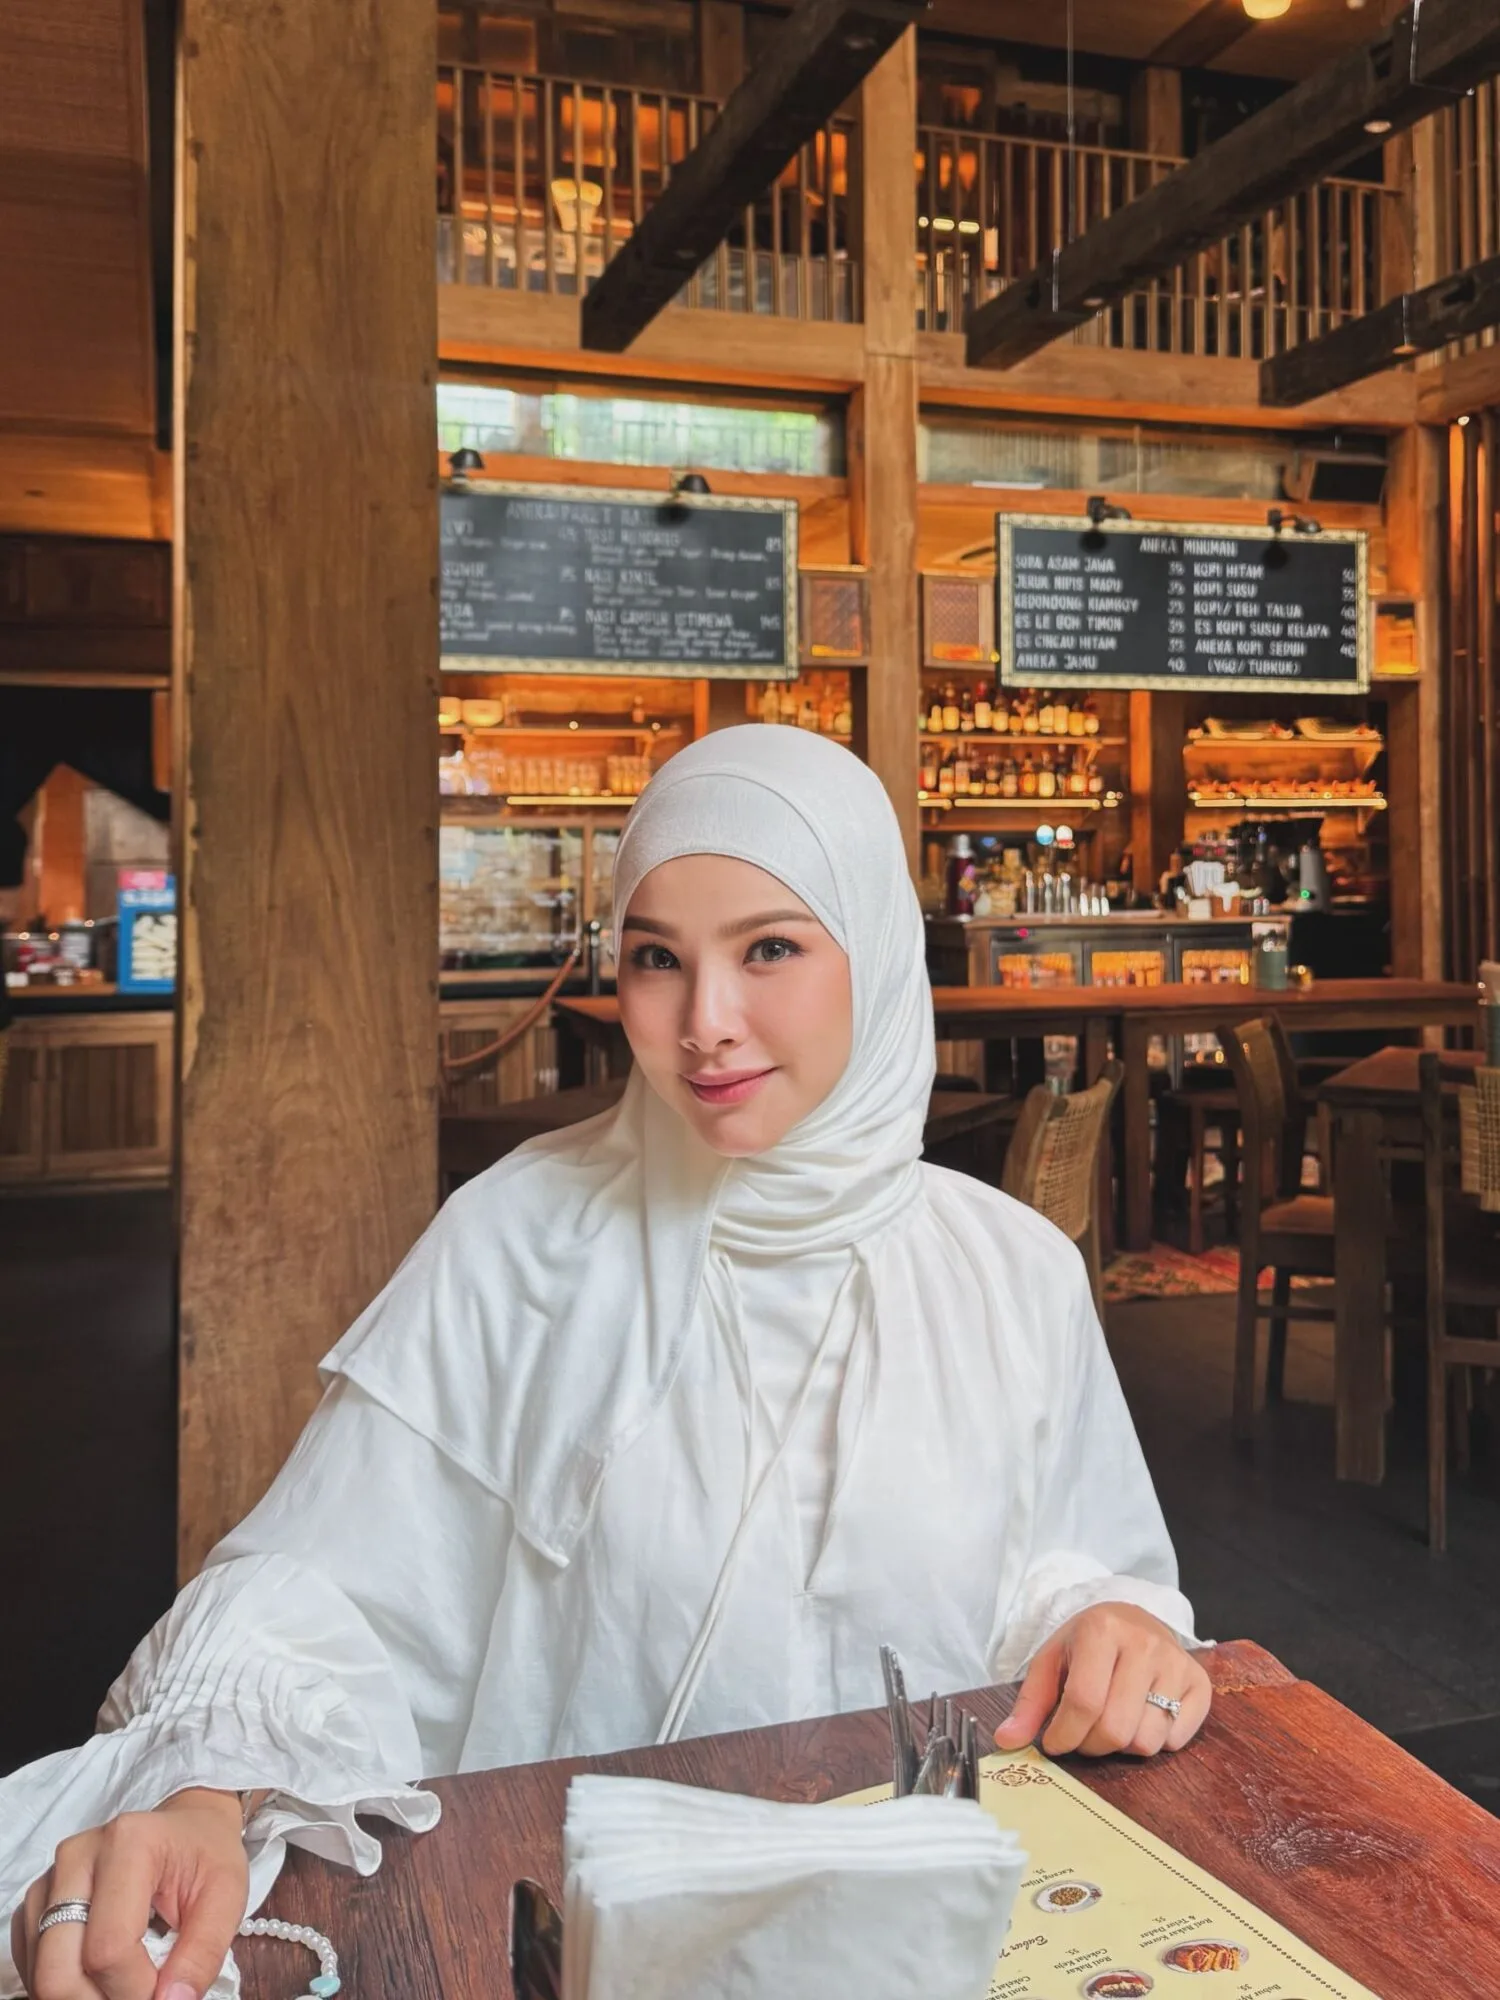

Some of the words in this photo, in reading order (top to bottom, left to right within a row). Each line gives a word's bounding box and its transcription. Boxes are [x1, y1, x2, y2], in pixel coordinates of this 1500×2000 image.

[1139, 538, 1177, 555] ANEKA
[1183, 539, 1239, 557] MINUMAN
[1047, 556, 1081, 571] ASAM
[1084, 558, 1116, 573] JAWA
[1193, 562, 1223, 578] KOPI
[1226, 563, 1265, 580] HITAM
[1053, 575, 1085, 592] NIPIS
[1193, 581, 1223, 597] KOPI
[1226, 583, 1258, 598] SUSU
[1015, 613, 1031, 629] ES
[1194, 620, 1213, 635] ES
[1216, 620, 1246, 636] KOPI
[1249, 622, 1283, 637] SUSU
[1287, 623, 1331, 639] KELAPA
[1015, 632, 1031, 649] ES
[1079, 635, 1118, 651] HITAM
[1194, 639, 1234, 655] ANEKA
[1236, 640, 1263, 656] KOPI
[1016, 653, 1058, 669] ANEKA
[1063, 654, 1099, 670] JAMU
[1043, 1867, 1075, 1880] Kacang
[1168, 1924, 1195, 1937] Bakar
[1193, 1917, 1214, 1928] Roti
[1010, 1935, 1048, 1951] Bubur
[1075, 1948, 1108, 1964] Cokelat
[1092, 1956, 1113, 1968] Roti
[1066, 1963, 1092, 1975] Bakar
[996, 1976, 1031, 1991] Cokelat
[1008, 1985, 1029, 1997] Roti
